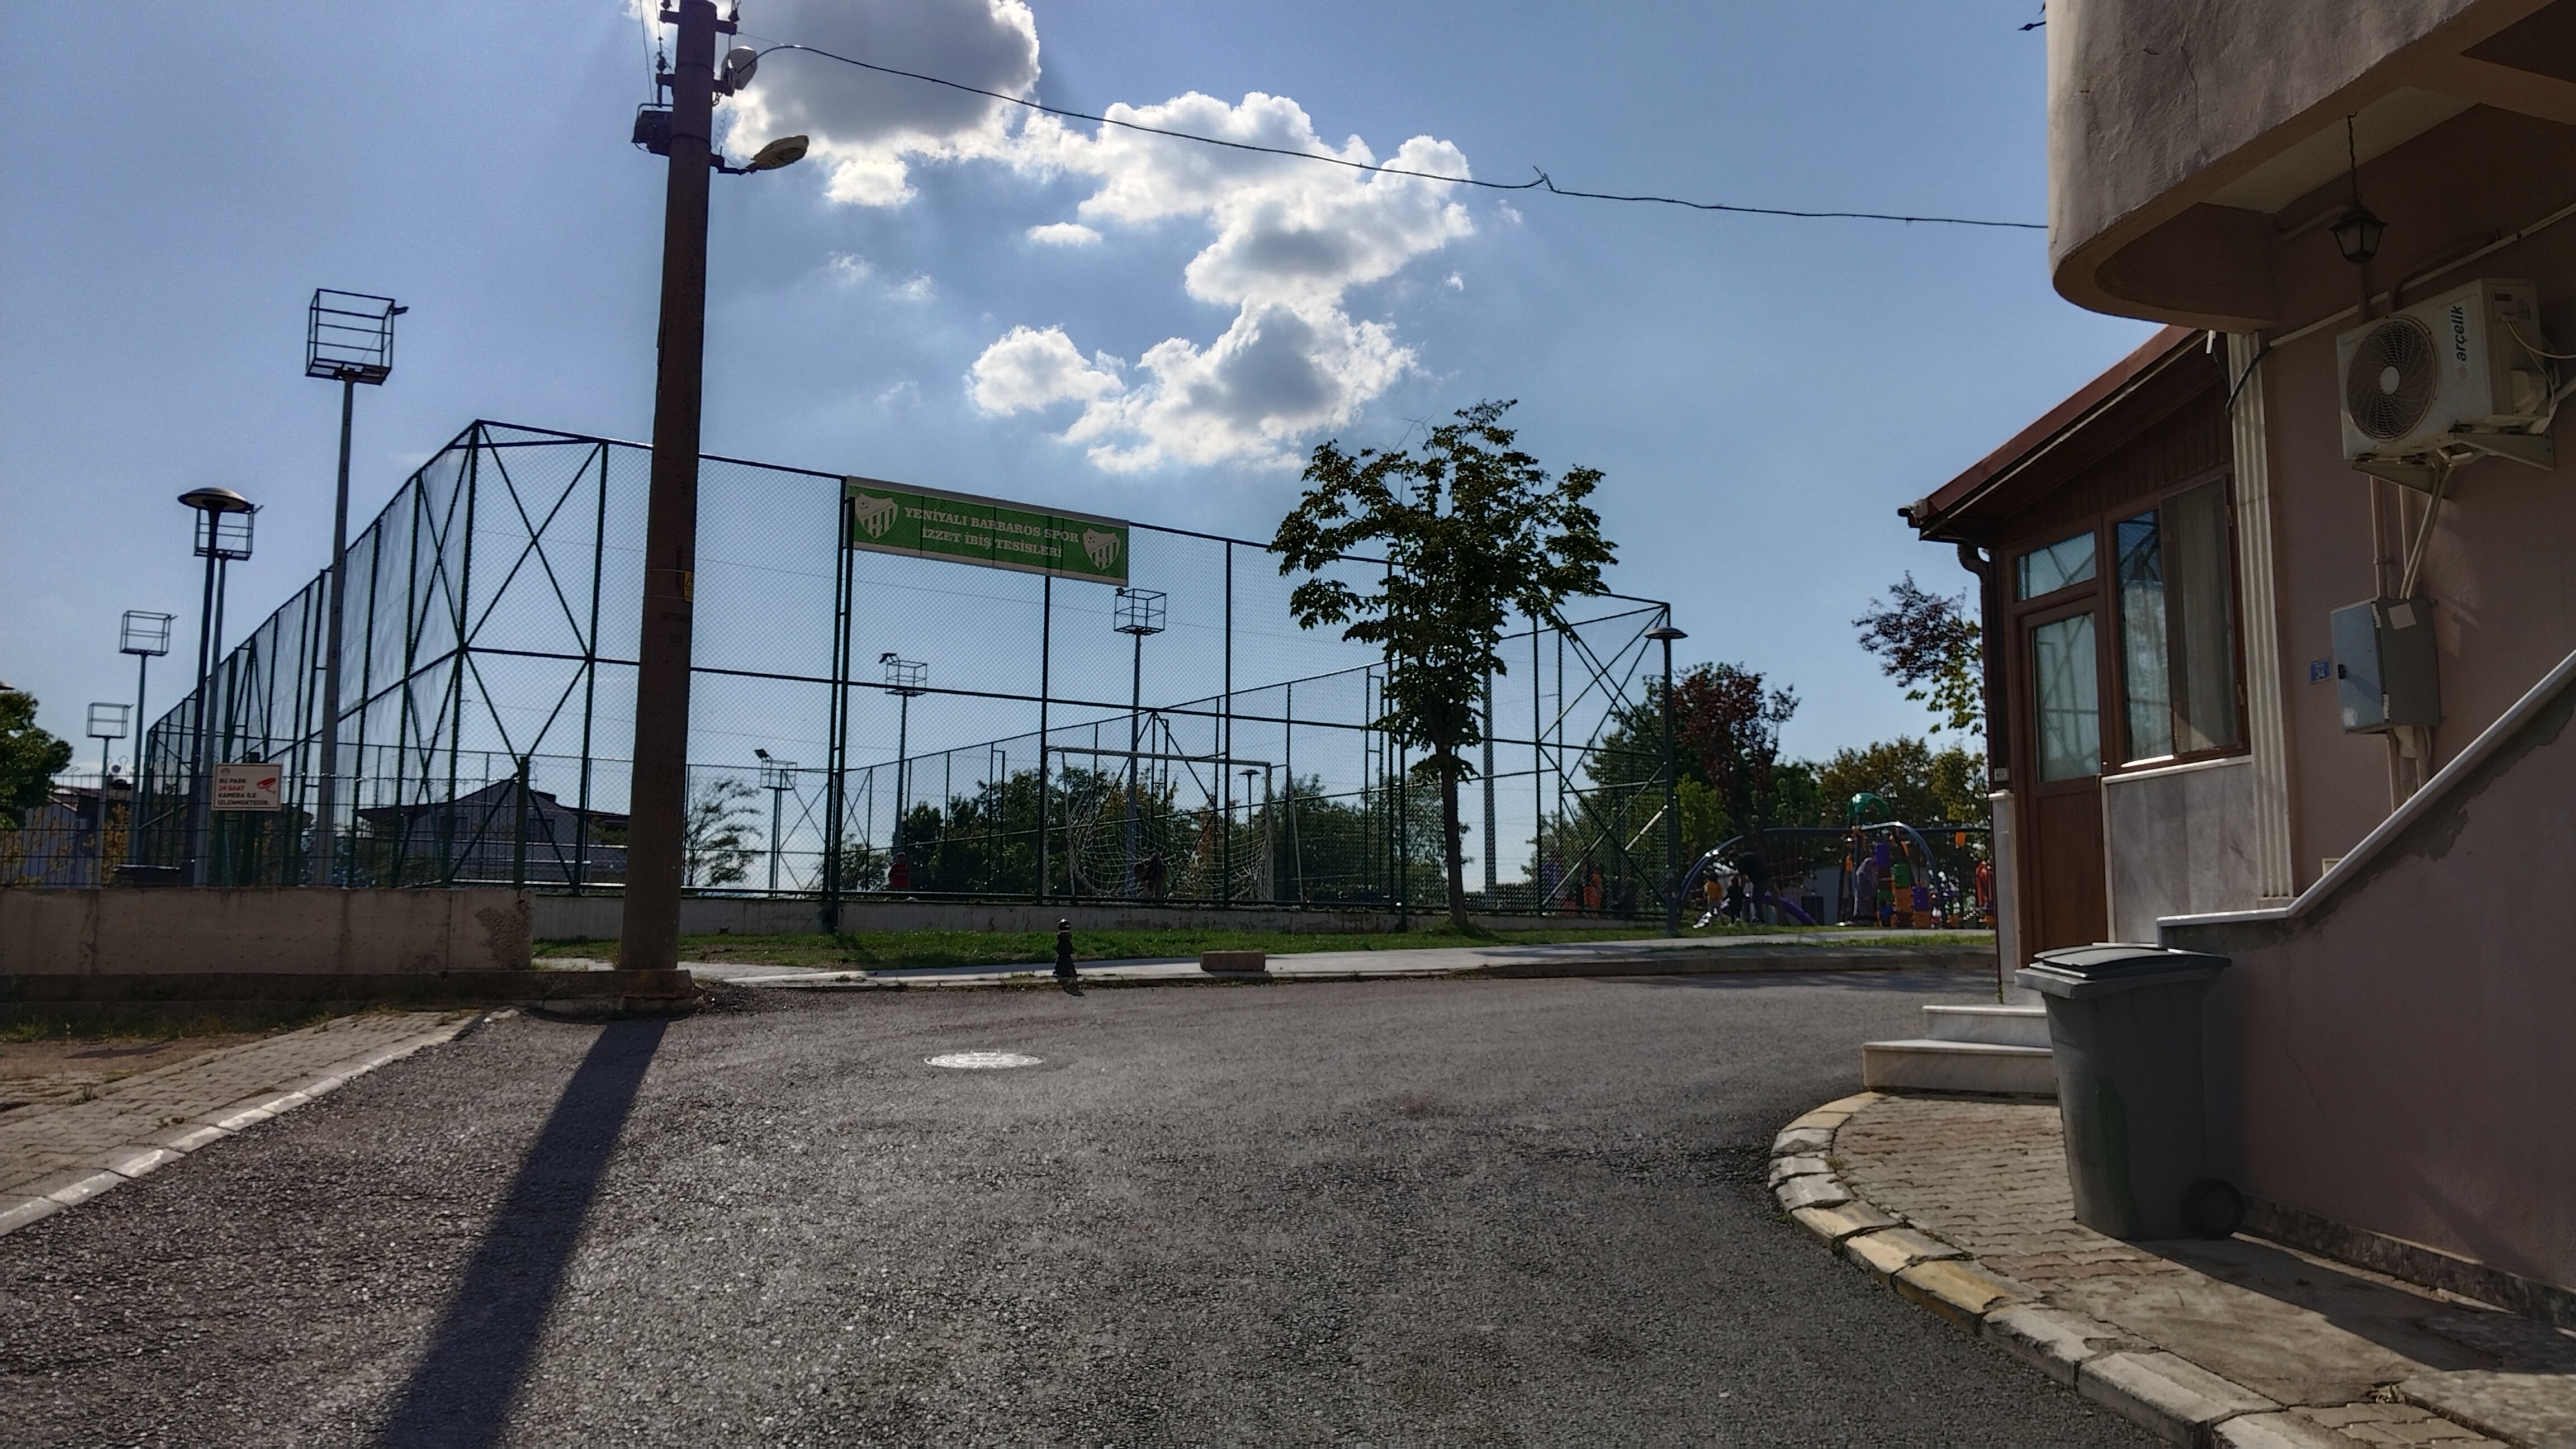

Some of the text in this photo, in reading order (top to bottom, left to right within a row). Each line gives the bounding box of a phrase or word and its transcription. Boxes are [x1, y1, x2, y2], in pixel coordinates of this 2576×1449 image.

[2451, 306, 2467, 361] arçelik
[903, 506, 1079, 543] YENİYALI BARBAROS SPOR
[922, 525, 1062, 557] İZZET İBİŞ TESİSLERİ
